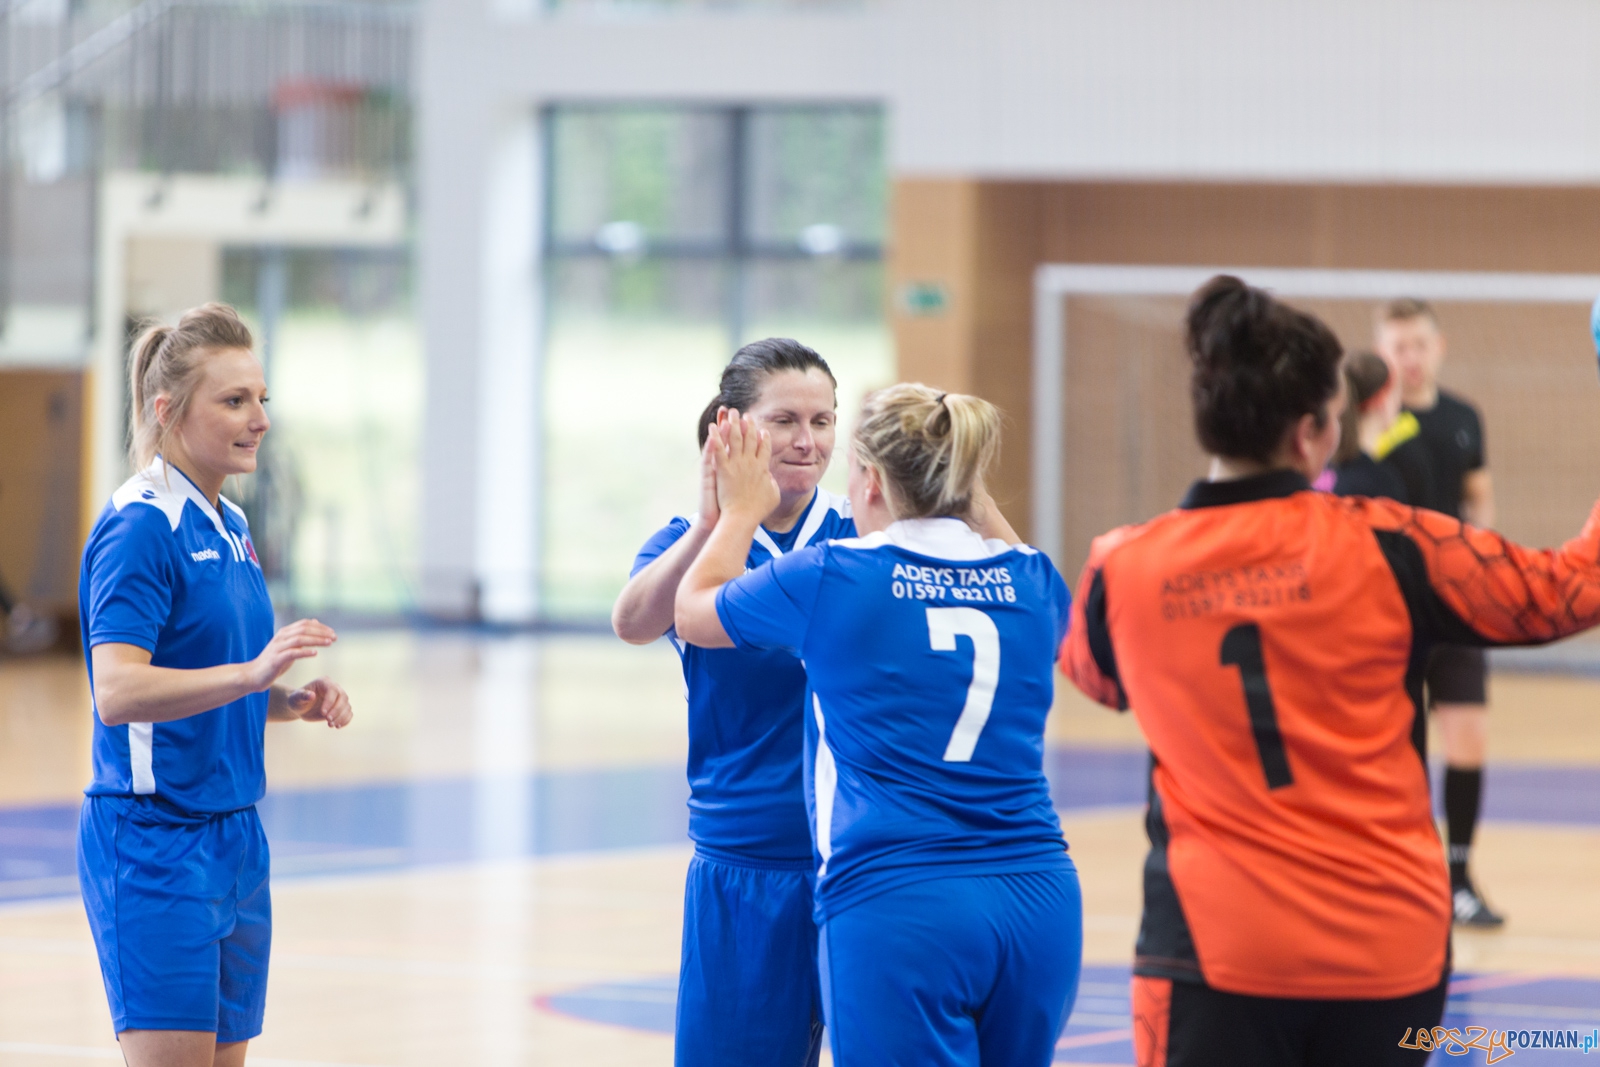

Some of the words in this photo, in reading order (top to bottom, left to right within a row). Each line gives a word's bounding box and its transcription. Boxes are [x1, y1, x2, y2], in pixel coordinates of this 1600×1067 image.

[892, 563, 954, 586] ADEYS
[956, 567, 1012, 586] TAXIS
[892, 581, 946, 600] 01597
[951, 585, 1017, 603] 822118
[925, 606, 1000, 762] 7
[1220, 621, 1294, 789] 1
